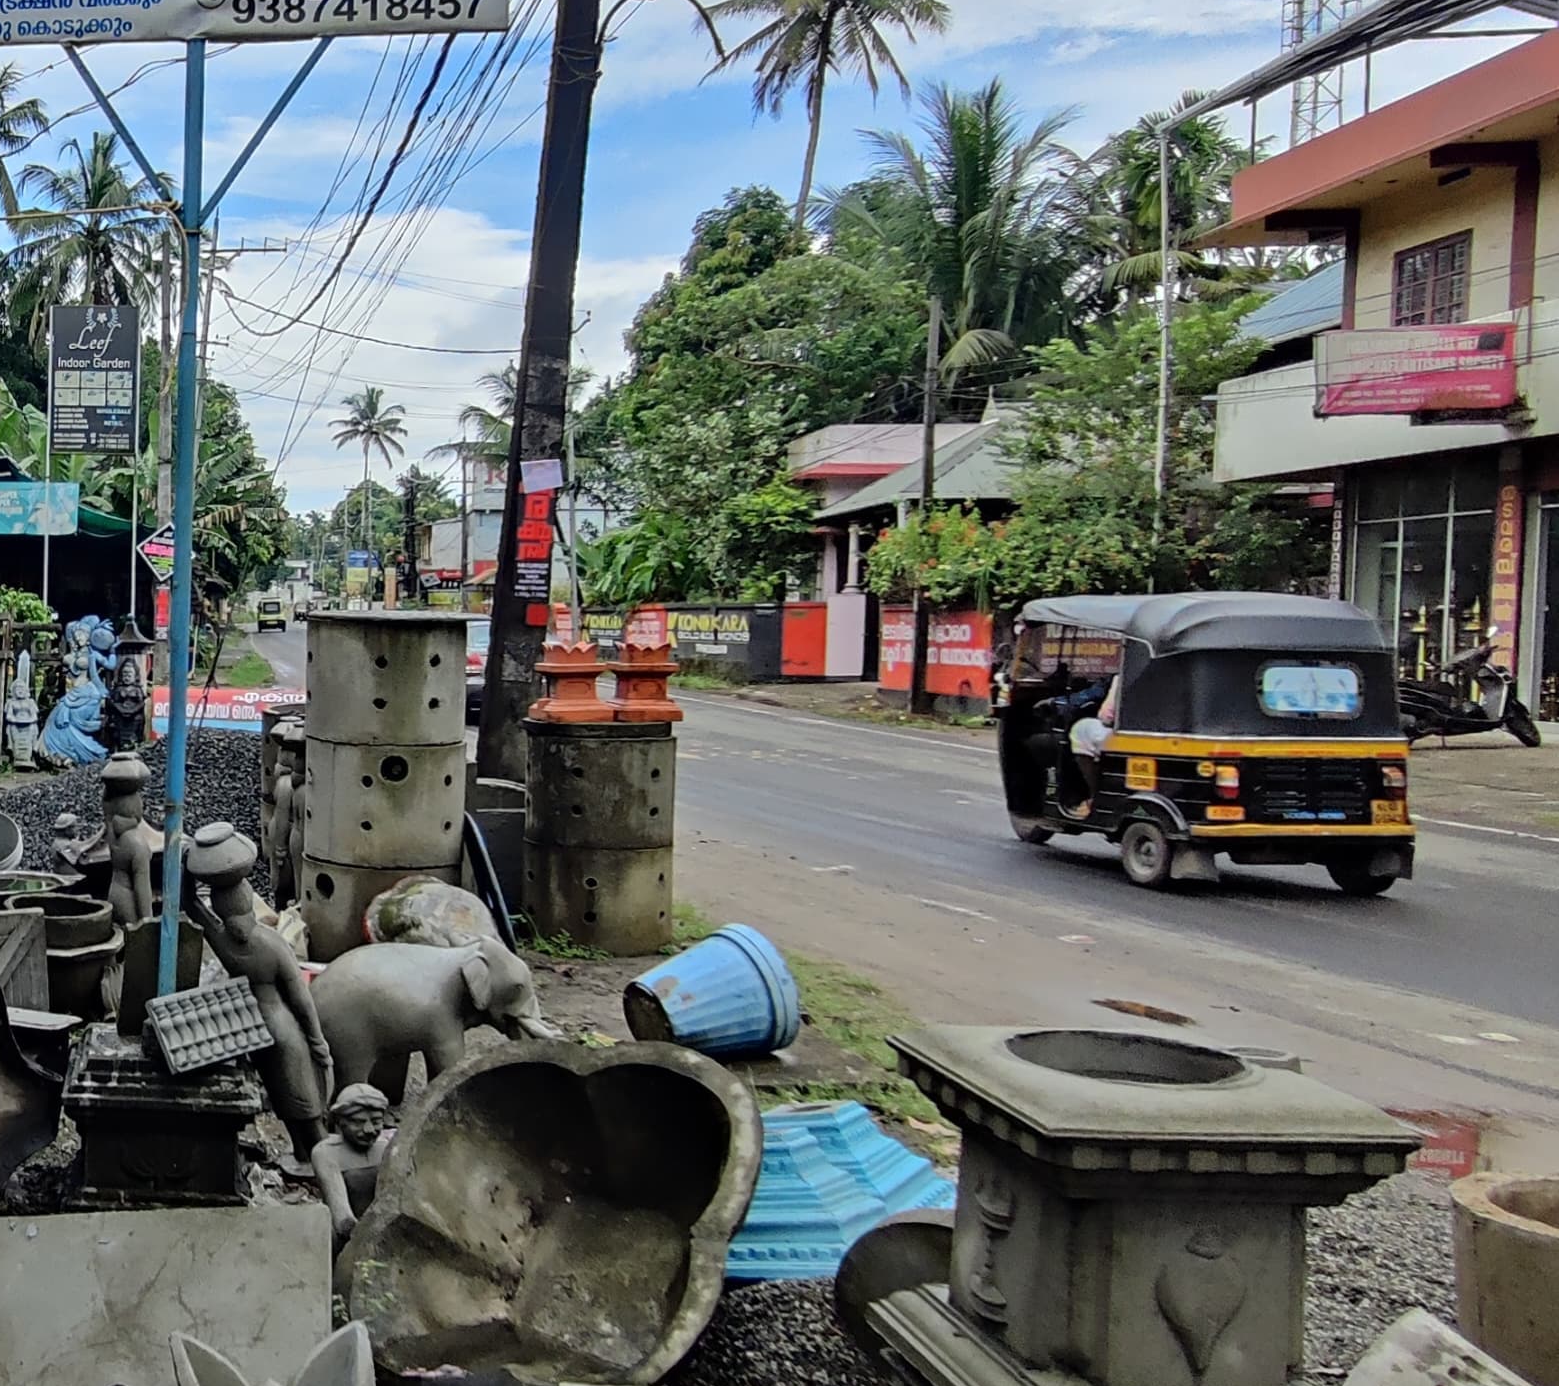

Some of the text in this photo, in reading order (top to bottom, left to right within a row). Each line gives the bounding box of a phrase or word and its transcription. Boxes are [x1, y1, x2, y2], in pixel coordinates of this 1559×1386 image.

[18, 16, 133, 38] കൊടുക്കും
[57, 356, 131, 368] Indoor Garden
